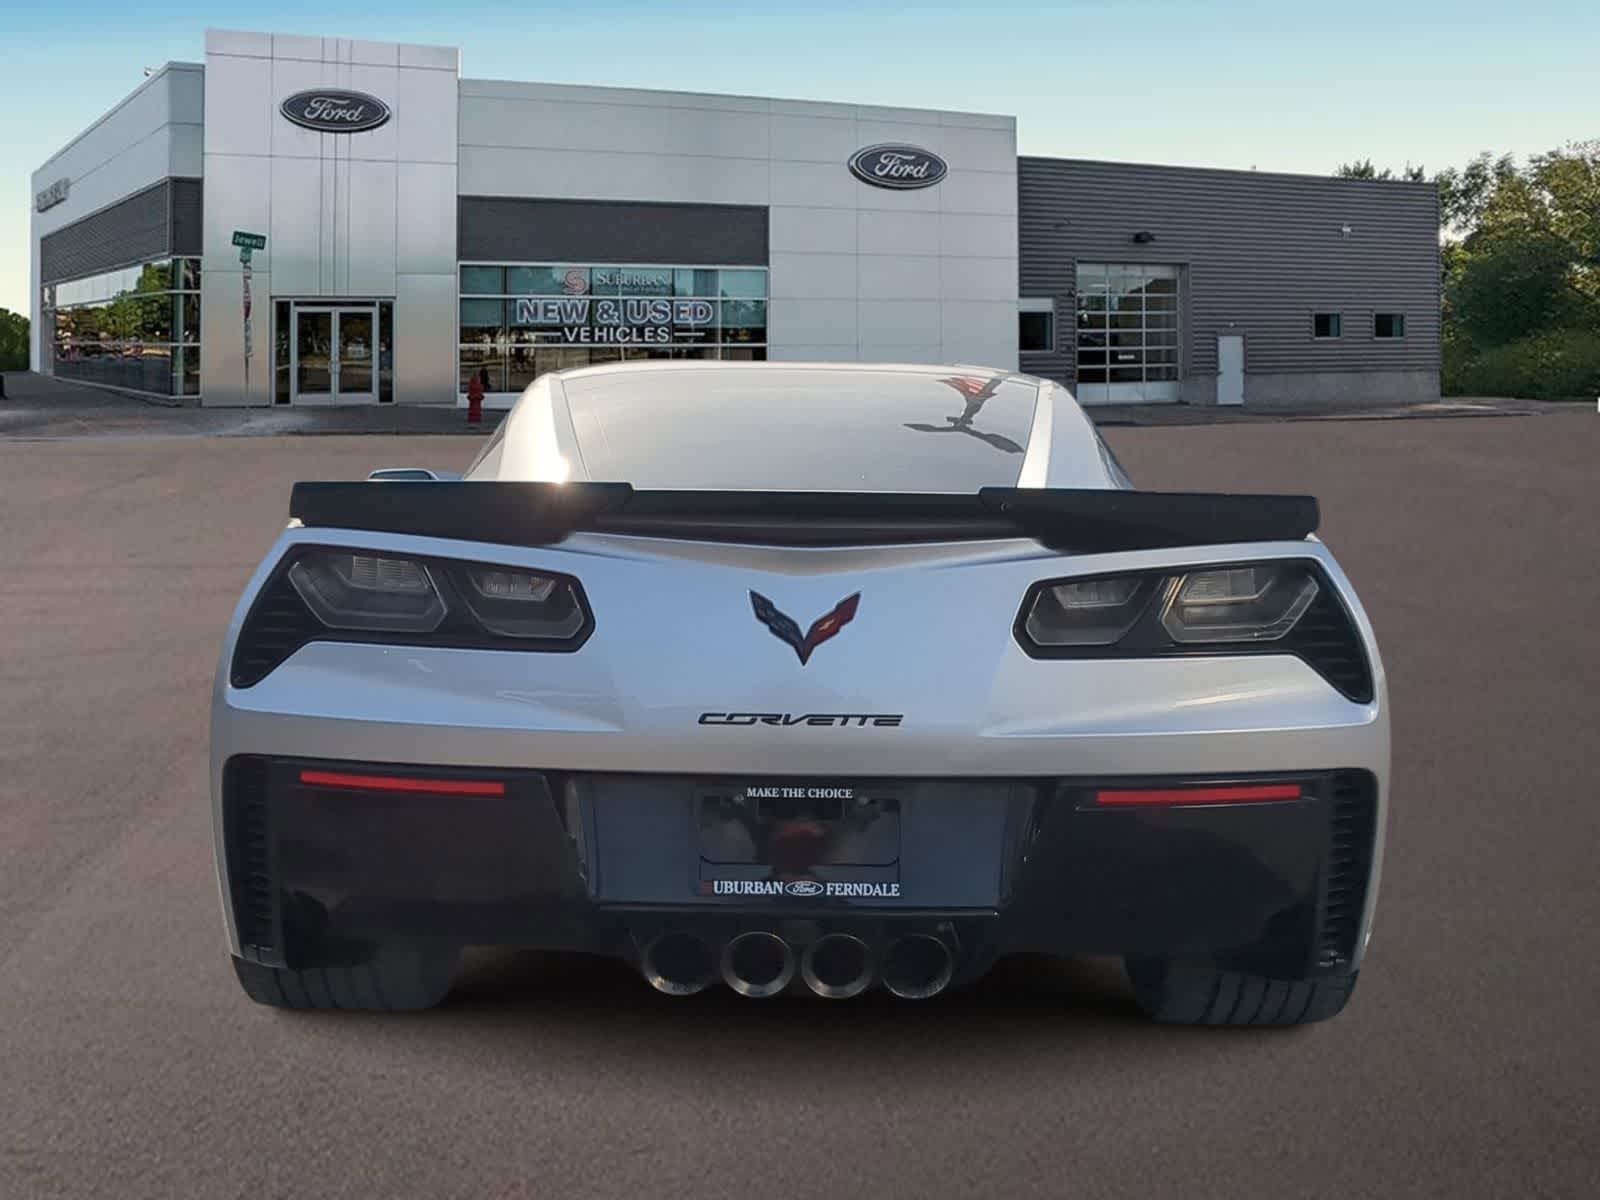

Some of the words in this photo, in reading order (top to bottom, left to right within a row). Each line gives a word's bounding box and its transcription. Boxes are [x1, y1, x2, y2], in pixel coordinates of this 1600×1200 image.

[304, 97, 365, 121] Ford
[874, 152, 930, 178] Ford
[517, 300, 589, 323] NEW
[595, 301, 620, 323] &
[626, 300, 714, 325] USED
[564, 326, 670, 343] VEHICLES
[698, 712, 904, 727] CORVETTE
[746, 787, 780, 798] MAKE
[781, 788, 805, 798] THE
[807, 788, 853, 799] CHOICE
[703, 880, 784, 895] UBURBAN
[826, 883, 900, 897] FERNDALE
